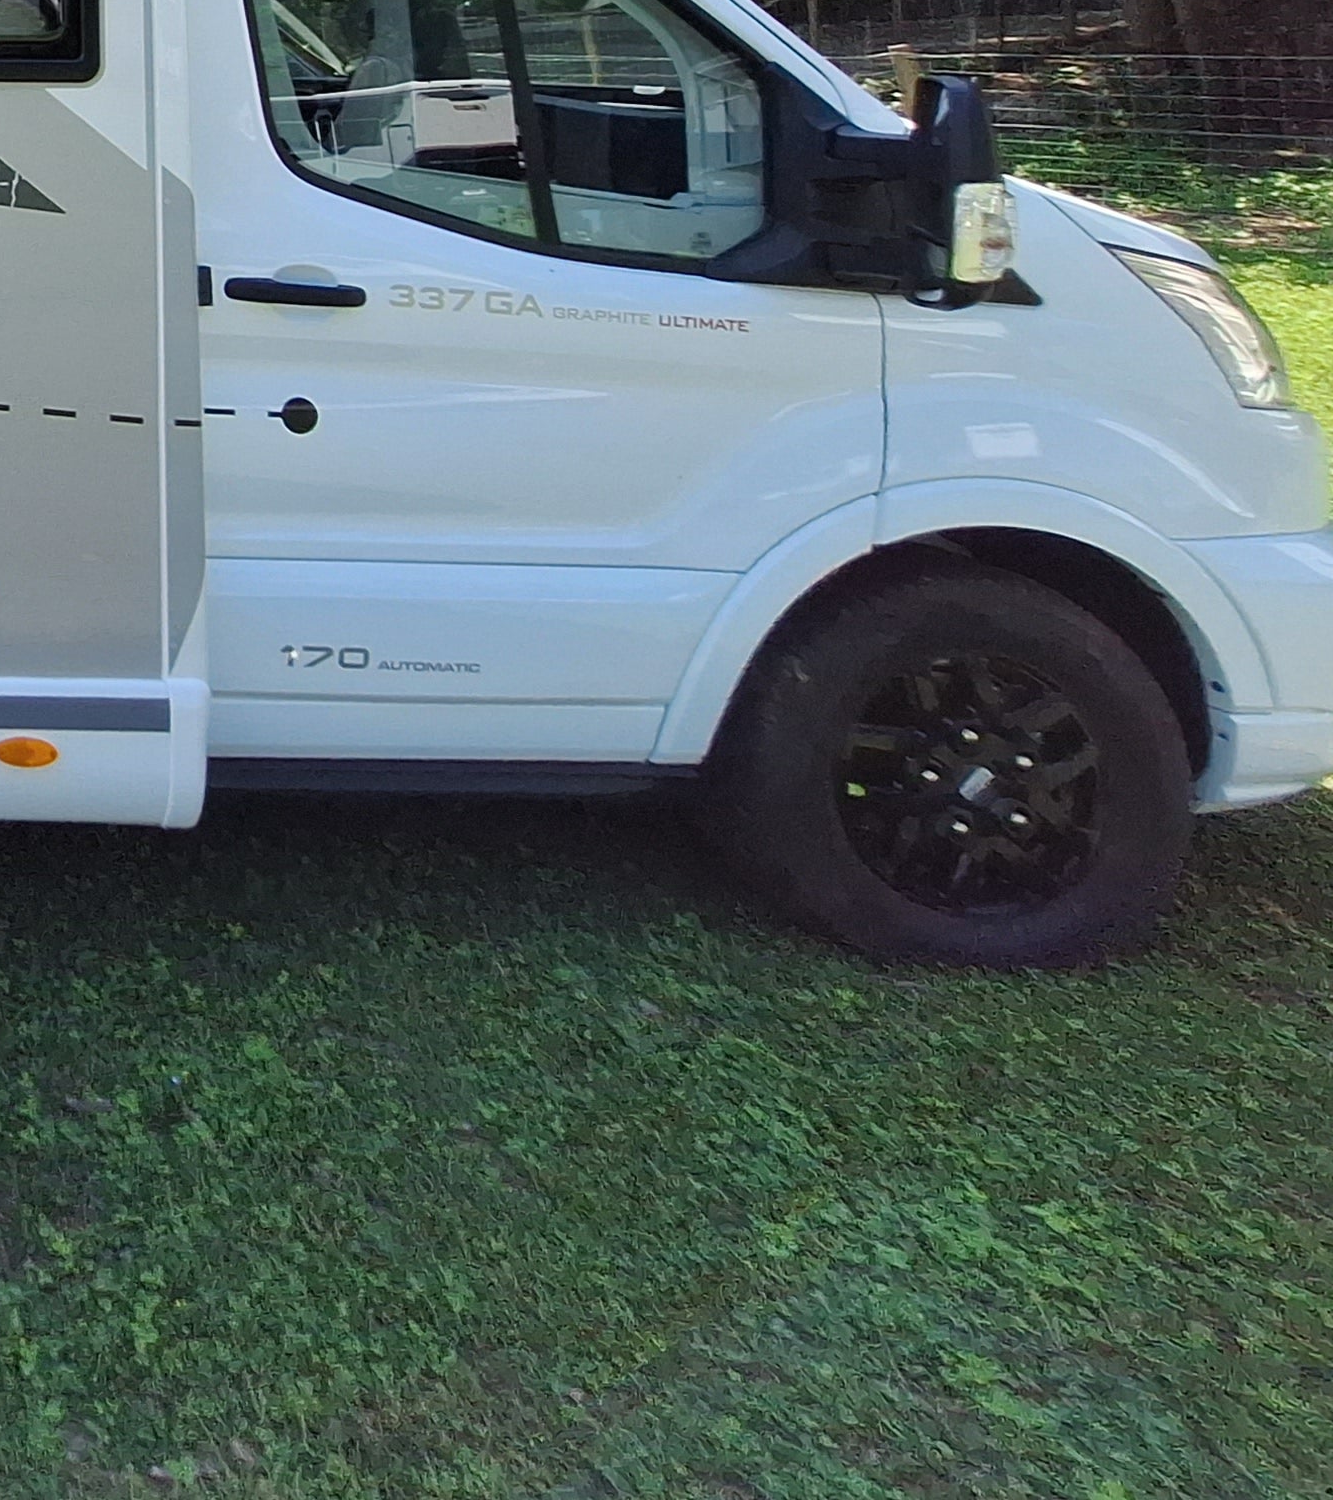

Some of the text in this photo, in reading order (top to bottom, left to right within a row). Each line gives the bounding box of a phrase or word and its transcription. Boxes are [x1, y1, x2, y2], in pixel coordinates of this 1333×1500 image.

[389, 284, 750, 333] 337 GA GRAPHITE ULTIMATE
[280, 644, 481, 673] 170 AUTOMATIC
